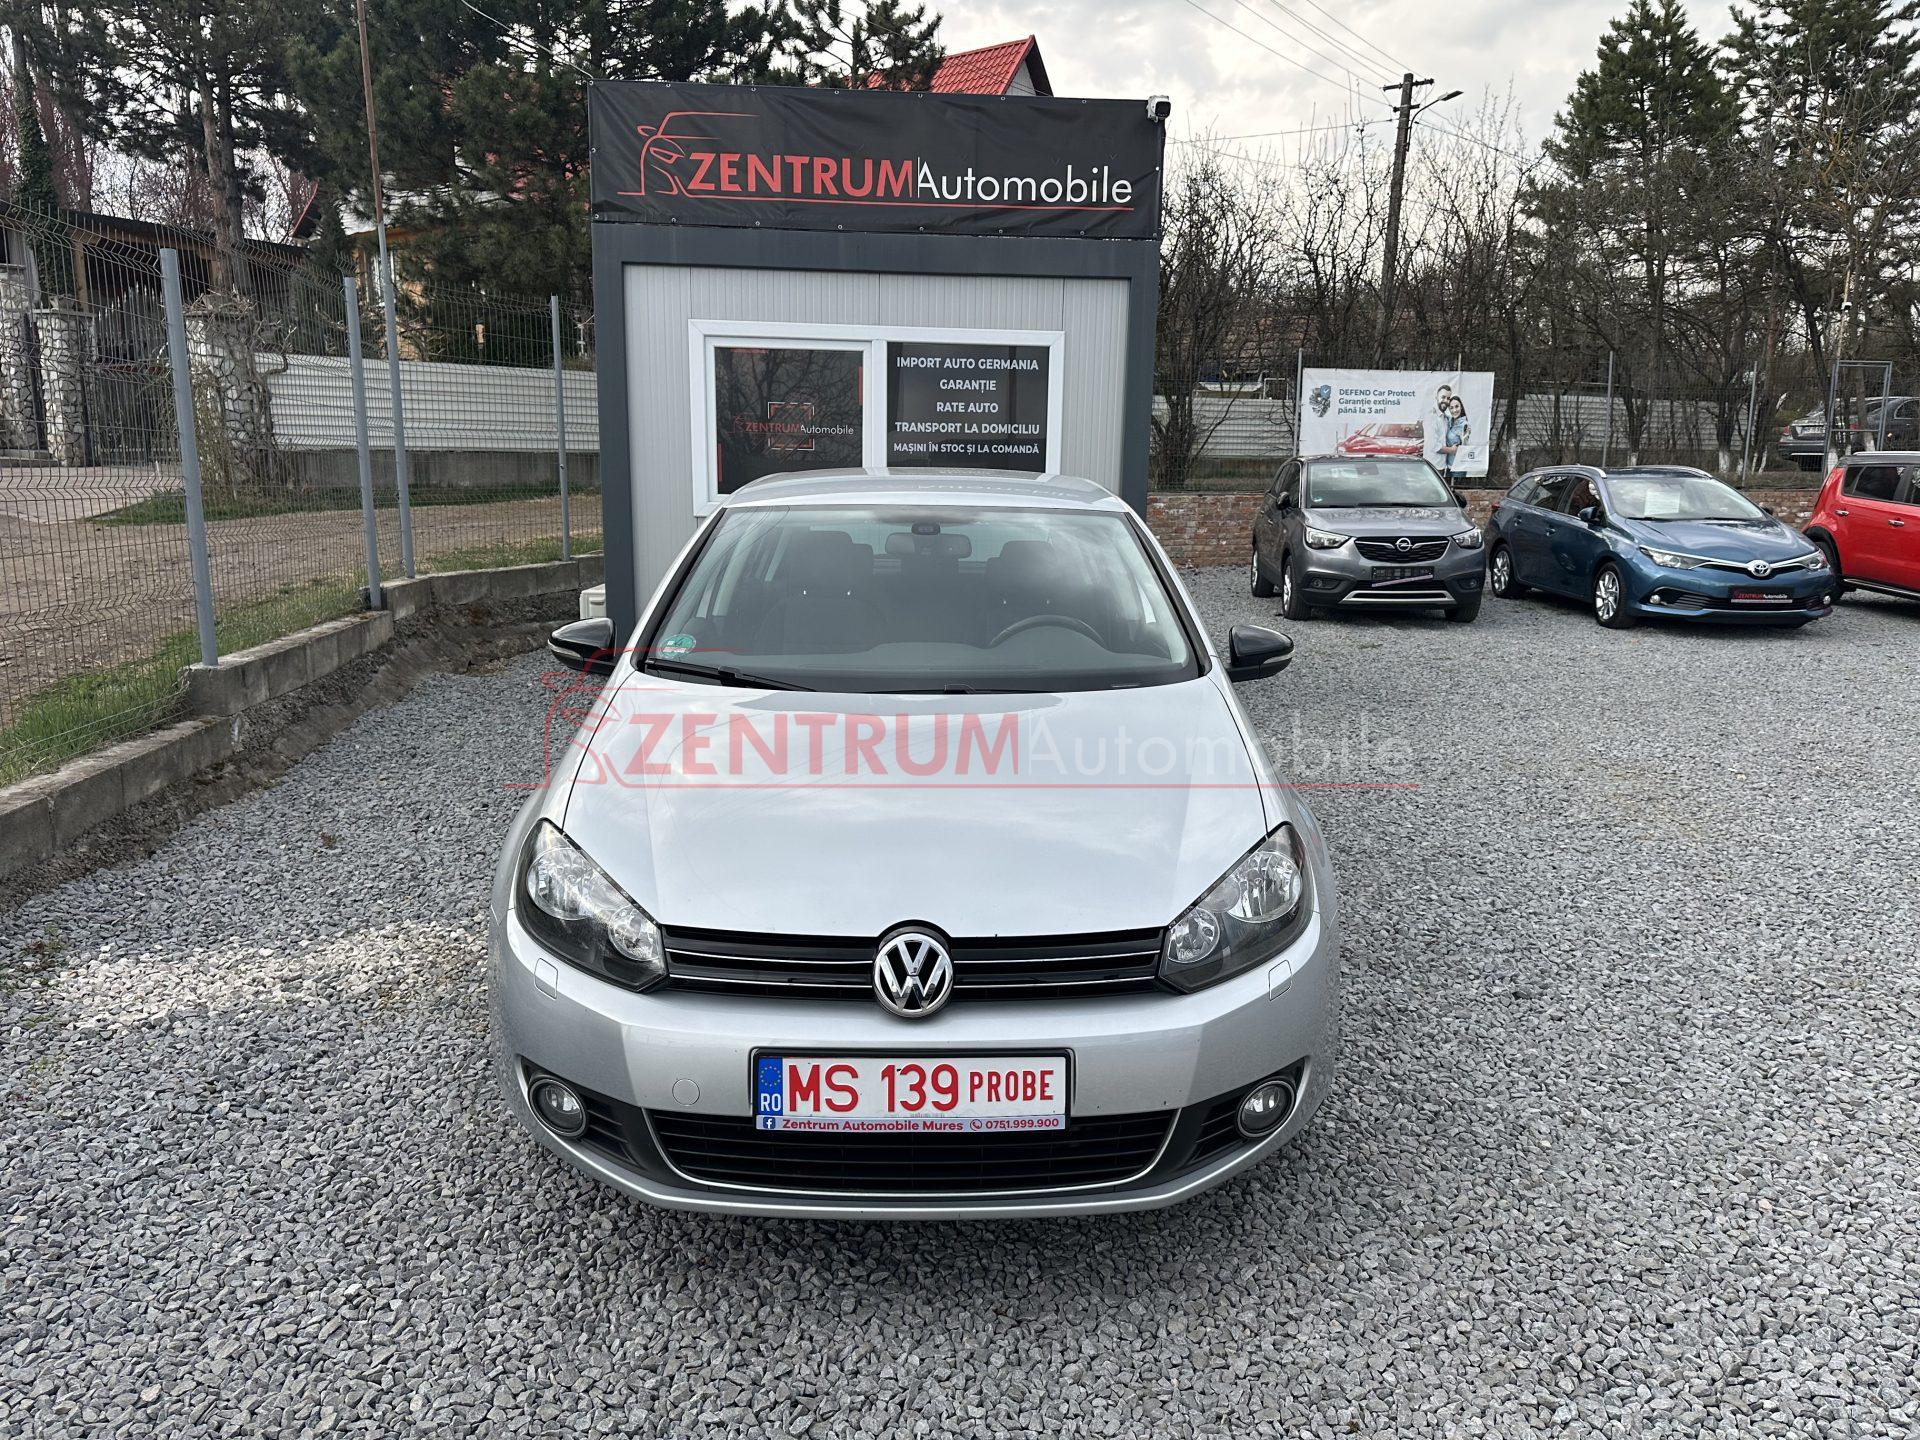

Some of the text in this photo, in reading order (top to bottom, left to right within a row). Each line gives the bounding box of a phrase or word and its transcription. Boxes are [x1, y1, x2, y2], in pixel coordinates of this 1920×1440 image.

[897, 357, 1038, 370] IMPORT AUTO GERMANIA
[940, 379, 996, 393] GARANȚIE
[937, 402, 998, 412] RATE AUTO
[895, 422, 1039, 434] TRANSPORT LA DOMICILIU
[894, 442, 1039, 455] MAȘINI ÎN STOC ȘI LA COMANDĂ
[788, 1064, 1054, 1112] MS 139 PROBE
[760, 1094, 781, 1112] RO
[783, 1119, 839, 1130] Zentrum
[842, 1120, 919, 1131] Automobile
[923, 1121, 963, 1131] Mures
[985, 1118, 1059, 1130] 0751.999.900
